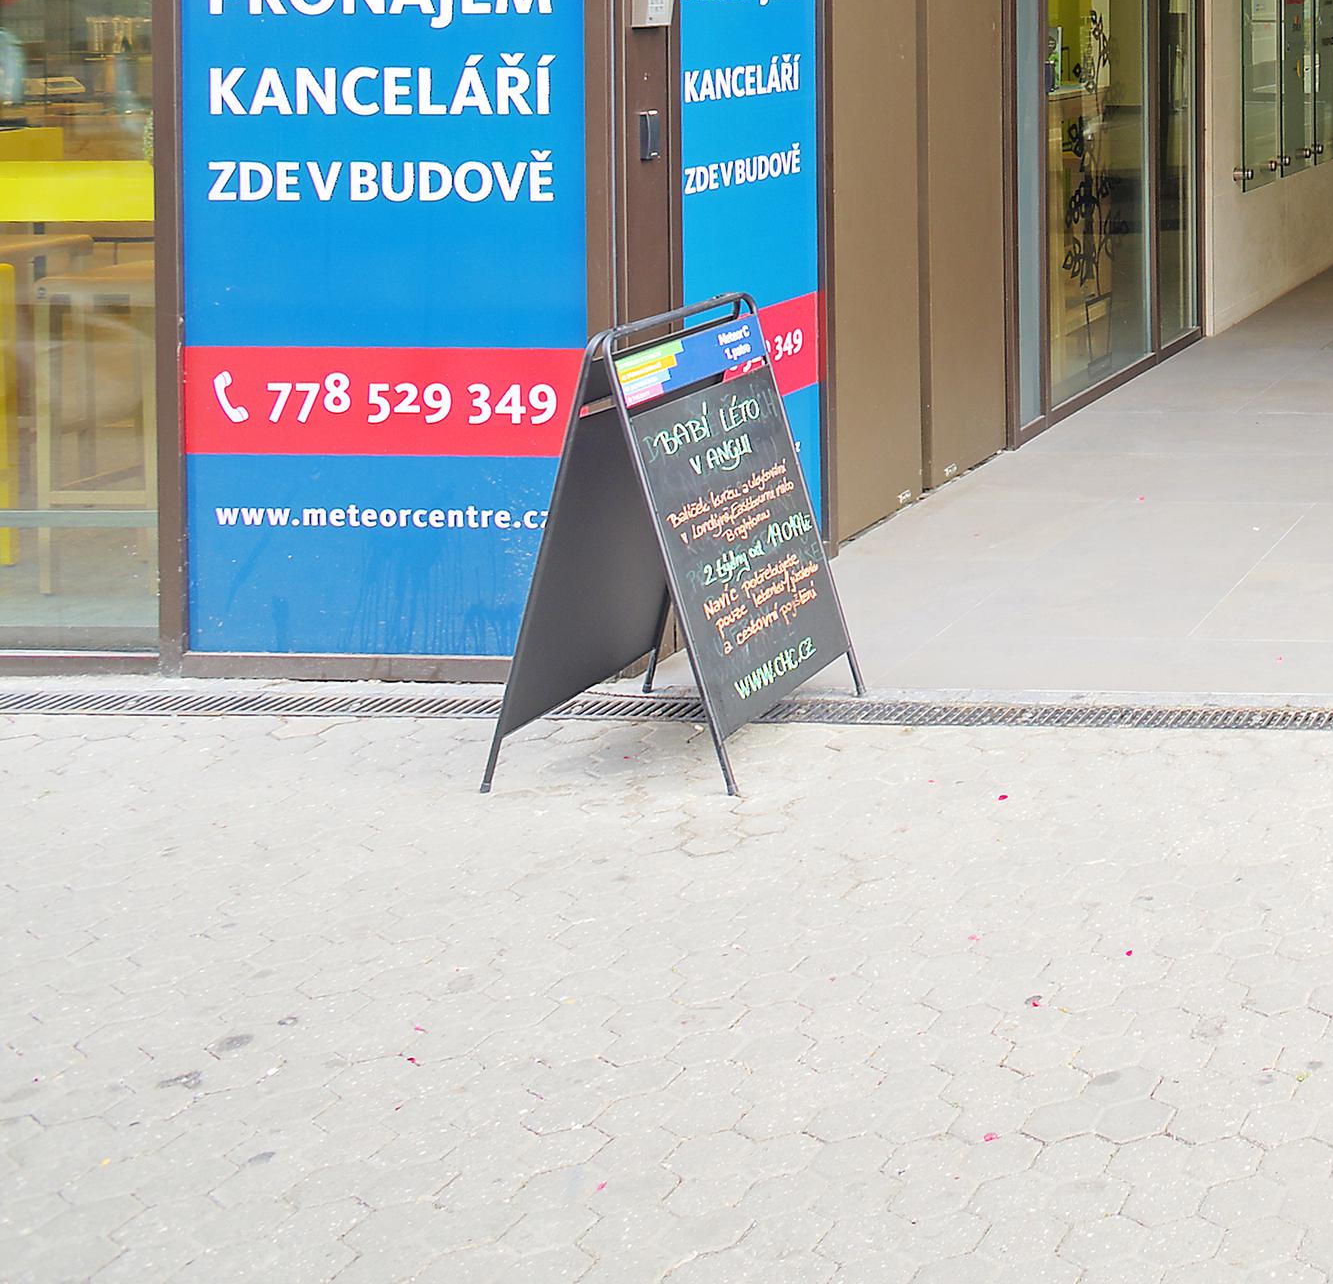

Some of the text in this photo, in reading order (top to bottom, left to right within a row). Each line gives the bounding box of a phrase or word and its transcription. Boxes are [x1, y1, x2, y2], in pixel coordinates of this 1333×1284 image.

[208, 52, 556, 116] KANCELÁŘÍ
[683, 53, 801, 104] KANCELÁŘÍ
[207, 149, 556, 203] ZDE V BUDOVĚ
[683, 142, 801, 196] ZDE V BUDOVĚ
[773, 328, 804, 362] 349
[266, 371, 558, 425] 778 529 349
[653, 395, 760, 455] BABÍ LÉTO
[689, 454, 703, 475] V
[703, 563, 717, 587] 2
